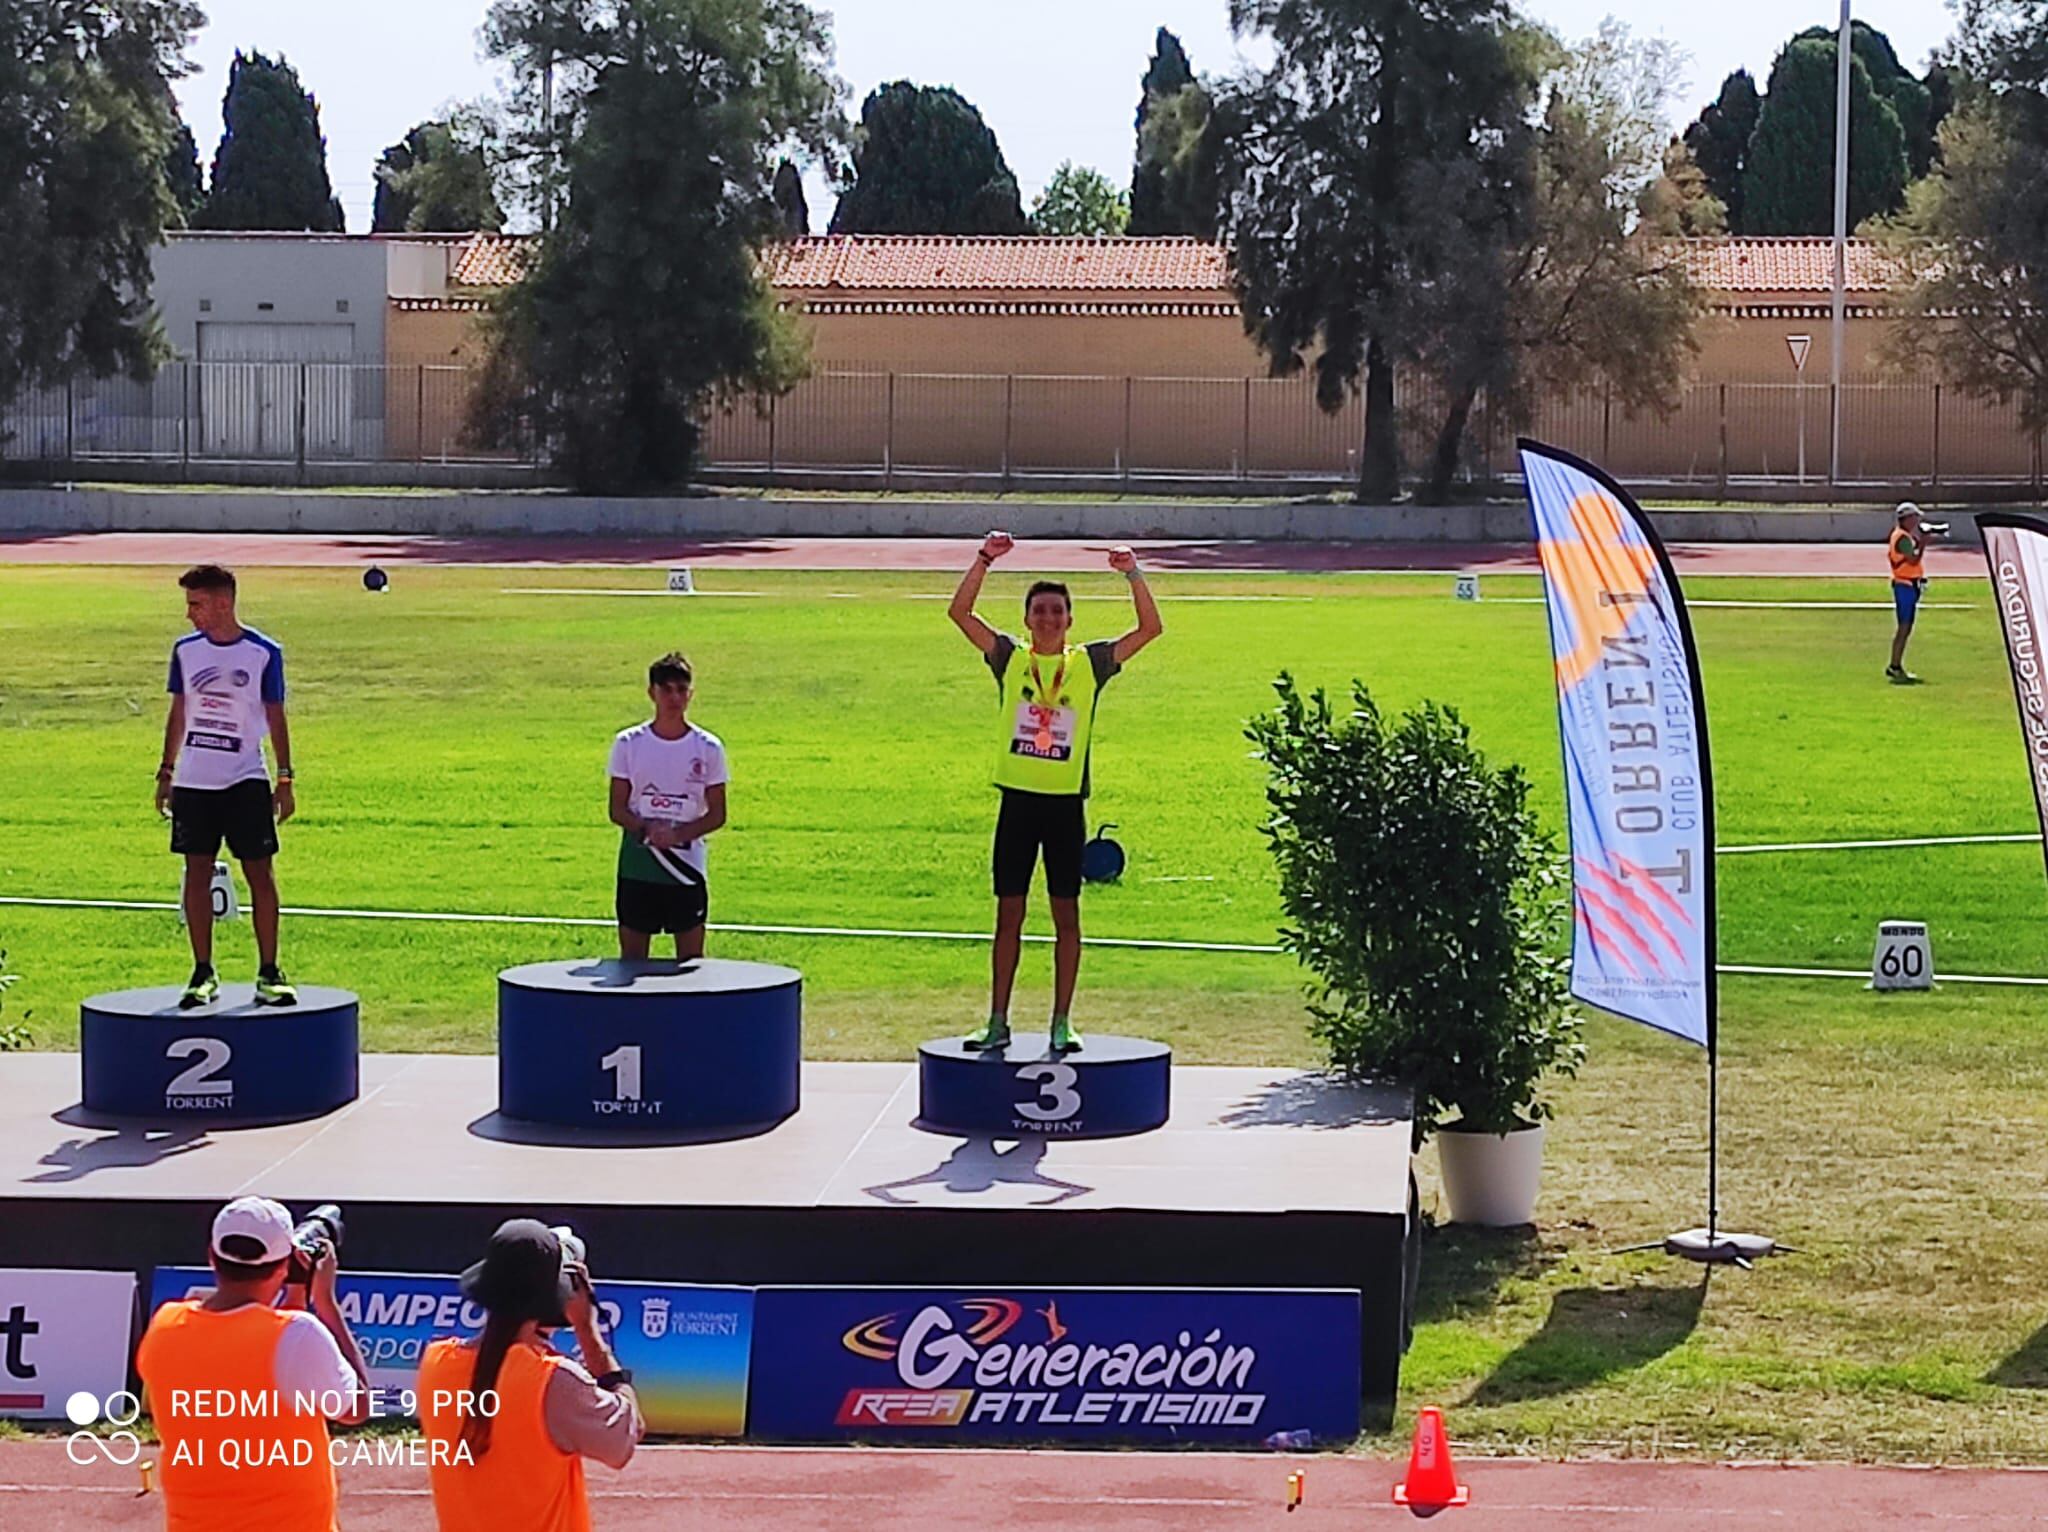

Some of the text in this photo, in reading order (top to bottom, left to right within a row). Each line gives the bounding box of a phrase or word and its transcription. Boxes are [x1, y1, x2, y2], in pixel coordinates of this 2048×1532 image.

[1880, 944, 1923, 977] 60
[166, 1037, 233, 1095] 2
[602, 1045, 641, 1100] 1
[166, 1096, 233, 1109] TORRENT
[1014, 1063, 1081, 1120] 3
[672, 1321, 738, 1335] TORRENT
[898, 1305, 1255, 1389] Generación
[852, 1392, 1266, 1424] RFEA ATLETISMO
